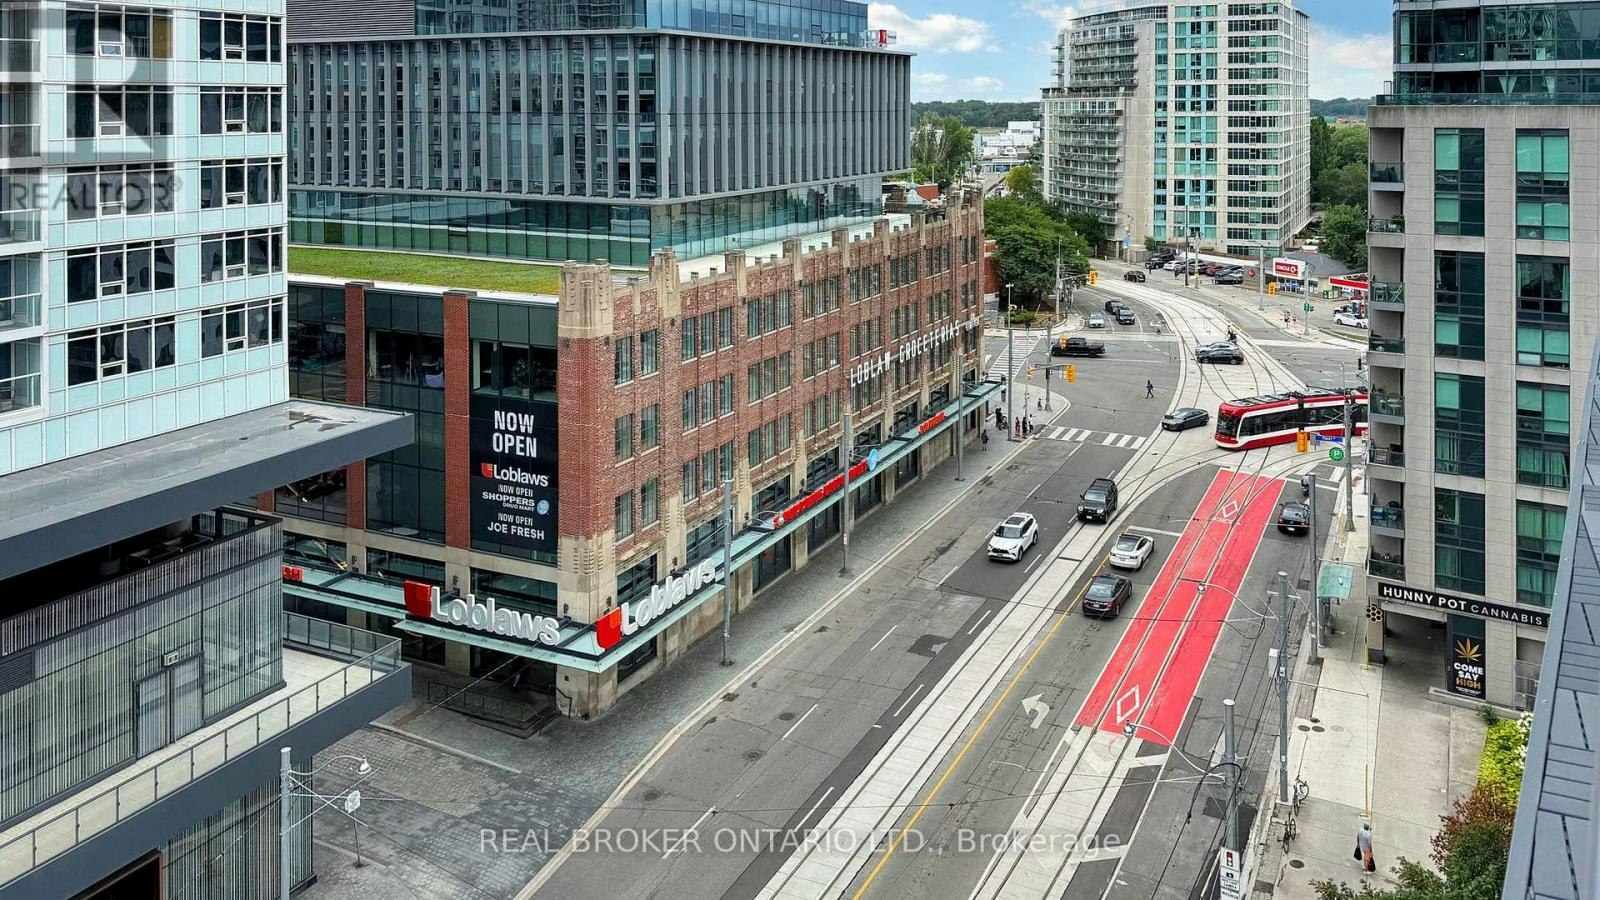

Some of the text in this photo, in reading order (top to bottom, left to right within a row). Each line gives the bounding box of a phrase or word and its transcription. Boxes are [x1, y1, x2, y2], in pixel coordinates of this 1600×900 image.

[850, 351, 891, 388] LOBLAW
[899, 319, 960, 364] GROCETERIAS
[494, 410, 535, 434] NOW
[492, 432, 537, 458] OPEN
[493, 464, 549, 487] Loblaws
[482, 491, 535, 507] SHOPPERS
[498, 484, 533, 497] NOW OPEN
[502, 502, 535, 512] DRUG MART
[498, 512, 533, 526] NOW OPEN
[487, 521, 545, 540] JOE FRESH
[621, 557, 715, 637] Loblaws
[1383, 586, 1433, 605] HUNNY
[1438, 597, 1467, 611] POT
[1470, 604, 1543, 626] CANNABIS
[431, 586, 560, 646] Loblaws
[1454, 662, 1484, 675] COME
[1458, 670, 1479, 681] SAY
[1456, 677, 1481, 690] HIGH
